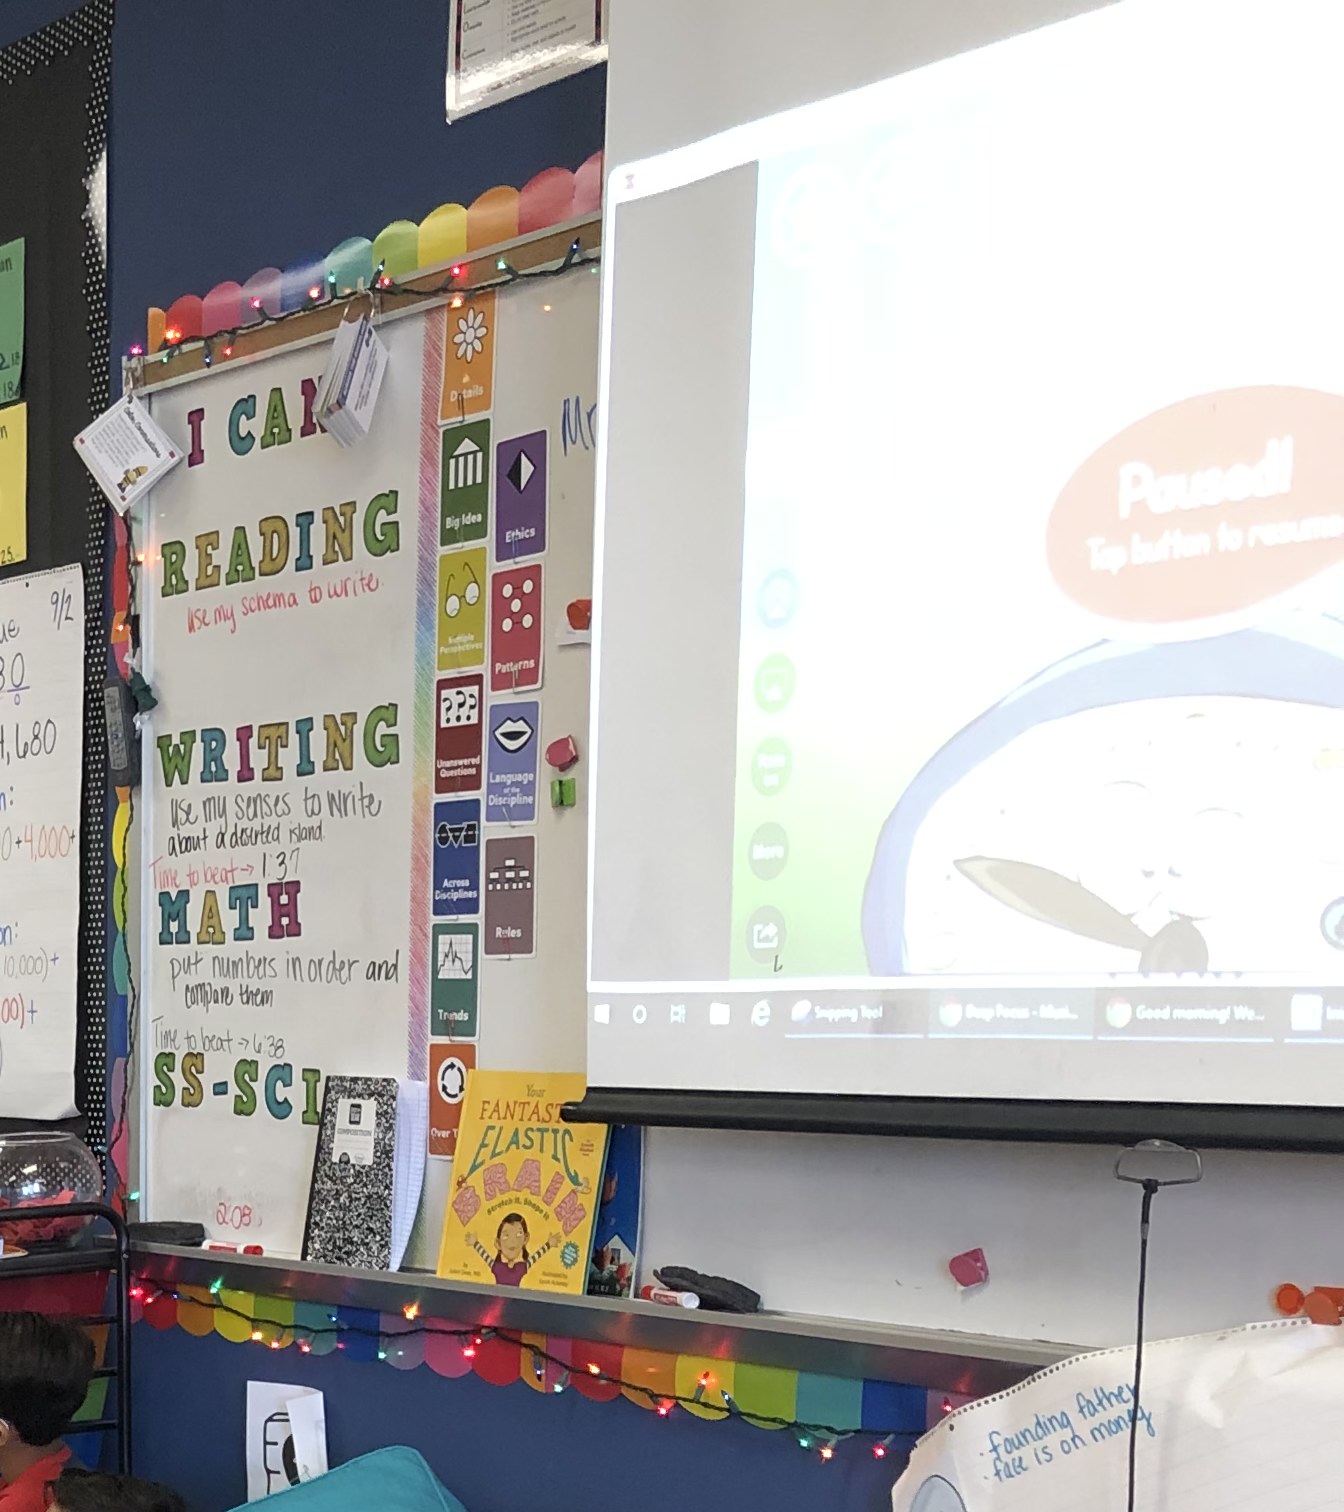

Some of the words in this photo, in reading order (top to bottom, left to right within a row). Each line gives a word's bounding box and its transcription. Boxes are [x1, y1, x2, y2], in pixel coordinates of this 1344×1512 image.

[187, 407, 206, 468] I
[445, 513, 461, 530] Big
[461, 511, 482, 526] Idea
[505, 526, 536, 545] Ethics
[161, 489, 400, 599] READING
[1130, 527, 1211, 565] button
[1217, 521, 1243, 552] to
[50, 588, 74, 630] 9/2
[213, 600, 238, 636] my
[241, 589, 300, 617] schema
[308, 580, 324, 605] to
[495, 658, 536, 675] Patterns
[157, 703, 400, 788] WRITING
[436, 755, 481, 769] Unanswered
[440, 765, 477, 779] Questions
[489, 771, 535, 786] Language
[203, 793, 228, 832] my
[234, 791, 292, 821] senses
[304, 786, 322, 819] to
[488, 794, 534, 807] Discipline
[167, 829, 209, 859] about
[229, 821, 281, 849] deserted
[149, 856, 181, 890] Time
[185, 864, 200, 887] to
[202, 857, 238, 886] beat
[262, 847, 301, 881] 1:37
[442, 879, 471, 890] Across
[158, 880, 303, 945] MATH
[434, 887, 478, 902] Disciplines
[170, 951, 203, 992] put
[212, 951, 278, 980] numbers
[308, 950, 360, 985] order
[365, 949, 400, 984] and
[185, 982, 234, 1013] compare
[238, 982, 274, 1008] them
[1136, 1005, 1170, 1020] Good
[151, 1016, 182, 1051] Time
[184, 1026, 199, 1051] to
[199, 1031, 235, 1055] beat
[525, 1084, 547, 1099] Your
[430, 1127, 451, 1139] Over
[466, 1124, 582, 1185] ELASTIC
[450, 1158, 588, 1238] BRAIN
[988, 1409, 1073, 1464] founding
[992, 1454, 1030, 1483] face
[1034, 1445, 1054, 1466] is
[1060, 1435, 1088, 1456] on
[1089, 1404, 1157, 1445] money
